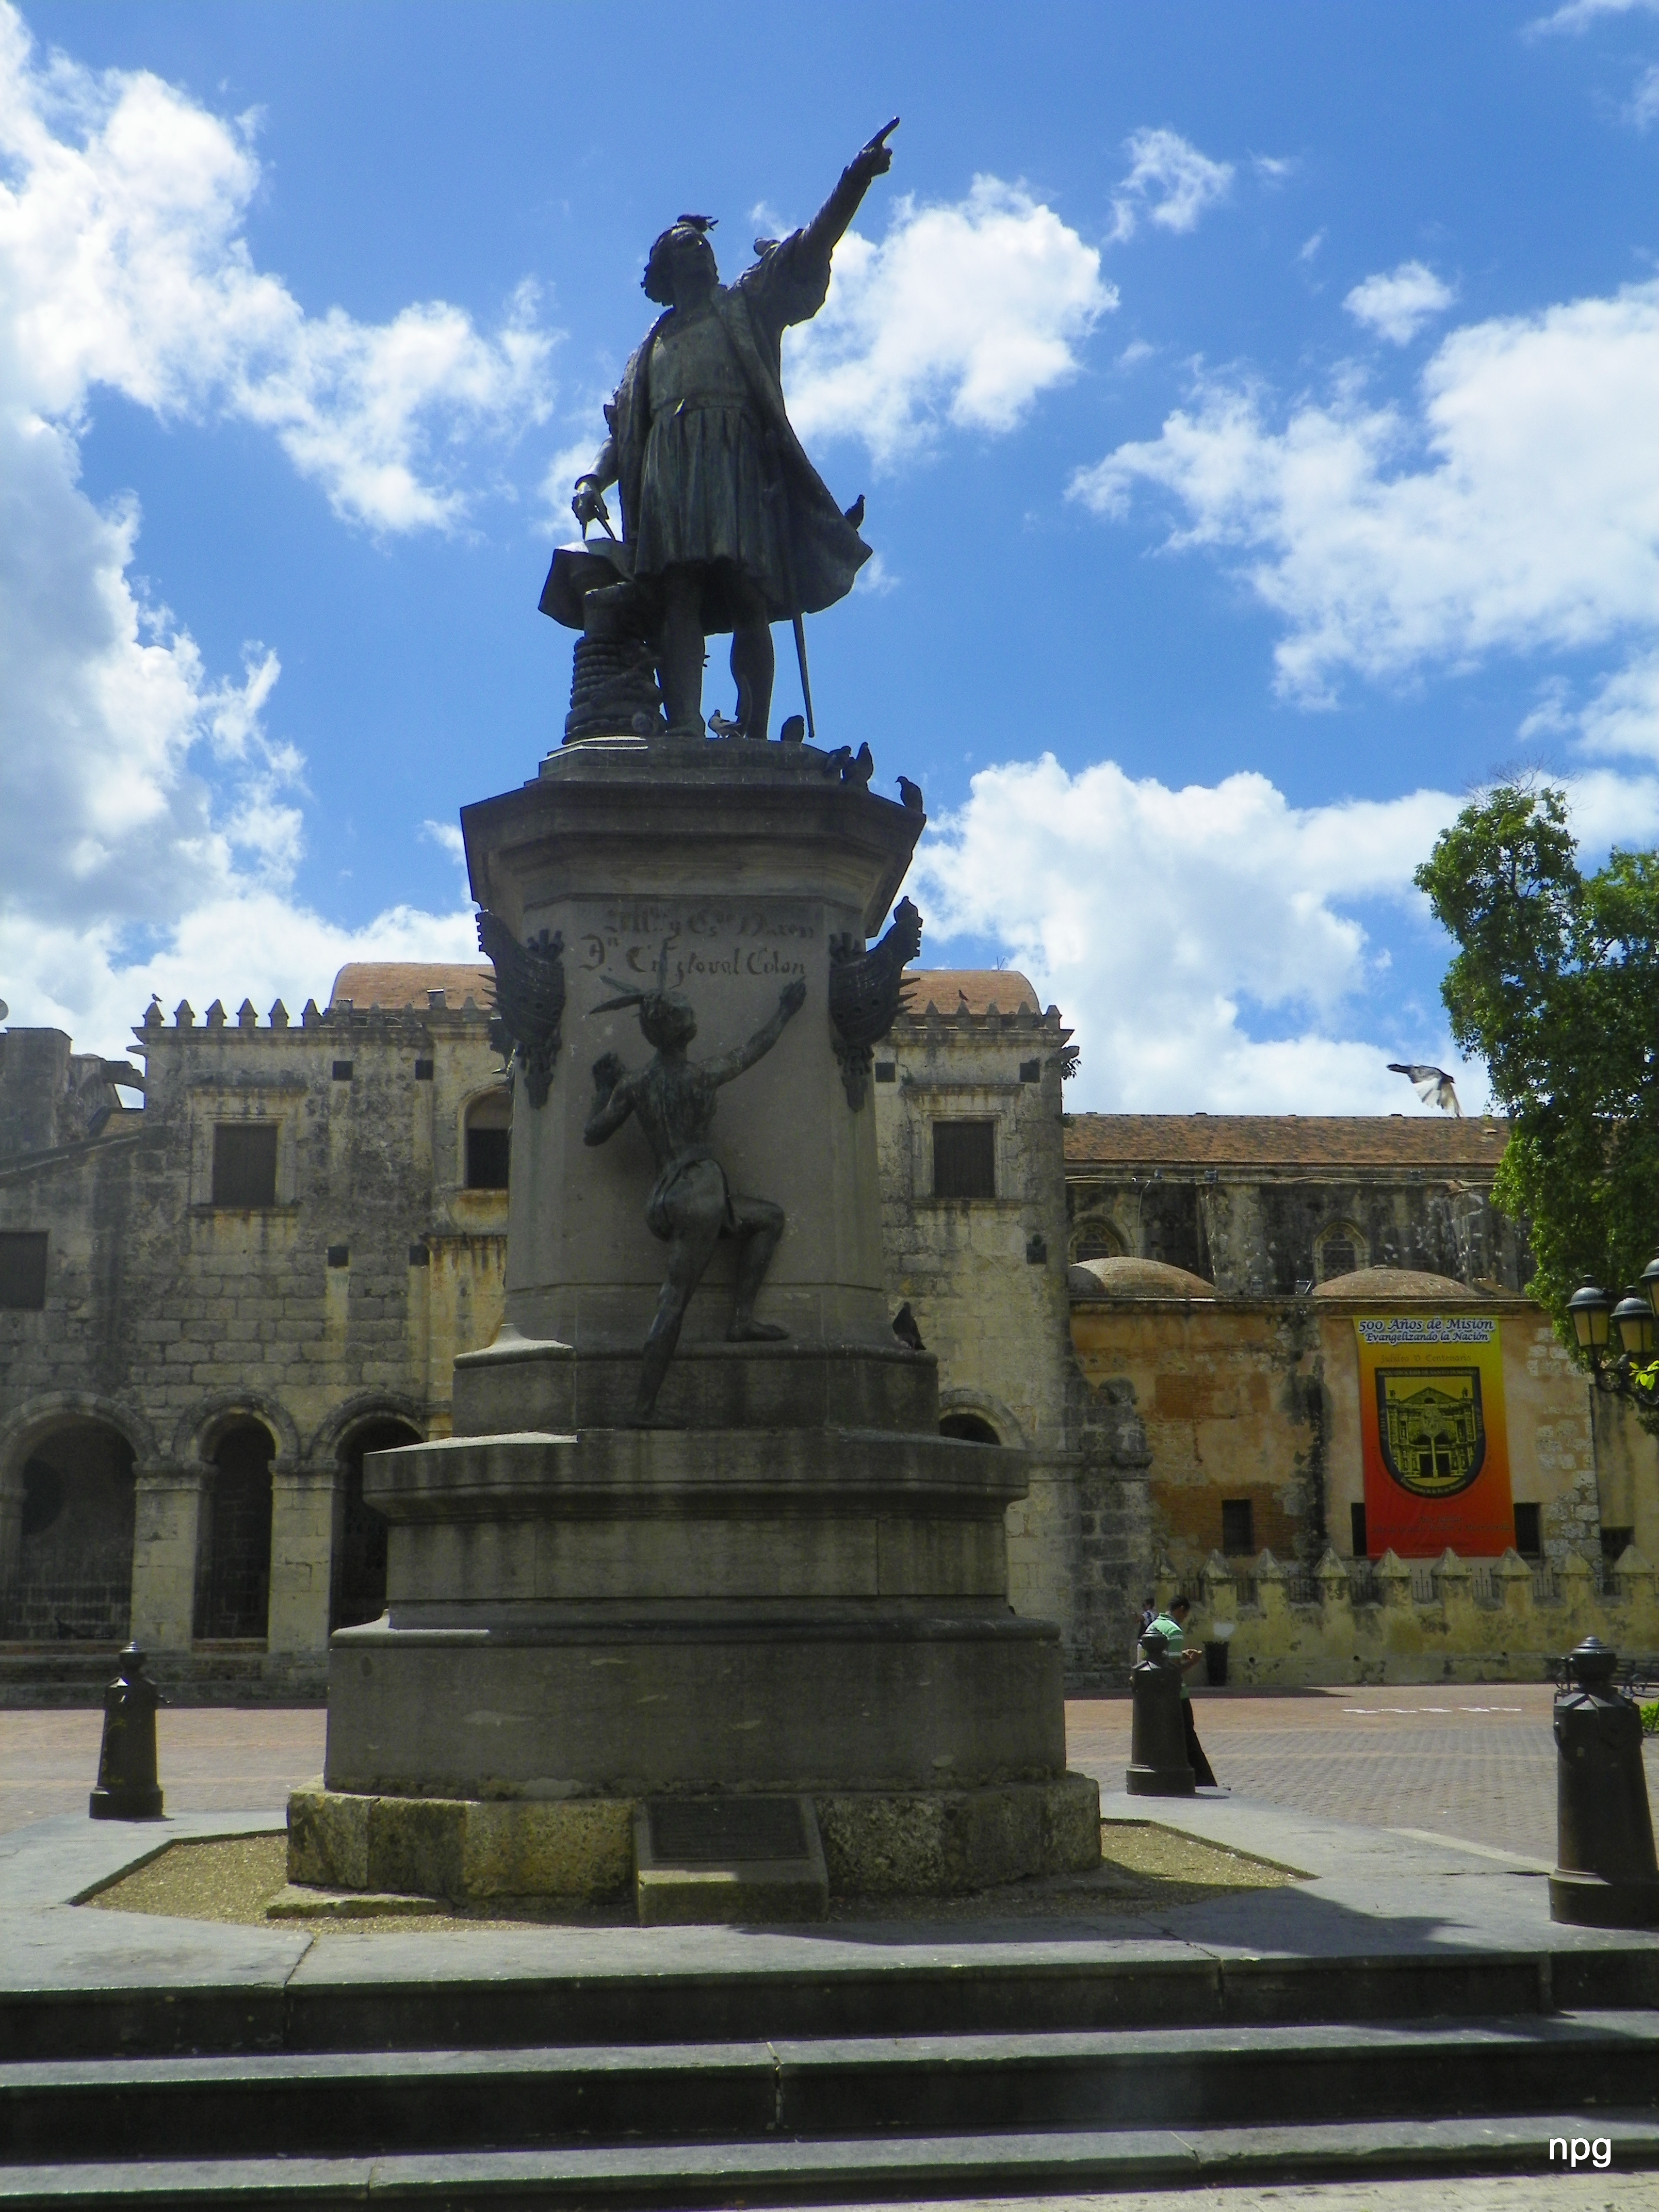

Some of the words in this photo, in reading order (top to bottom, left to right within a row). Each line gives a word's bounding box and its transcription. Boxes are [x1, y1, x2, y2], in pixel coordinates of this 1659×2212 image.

[1359, 1320, 1384, 1332] 500
[1388, 1318, 1423, 1330] Años
[1427, 1318, 1442, 1330] de
[1446, 1318, 1494, 1330] Misión
[1366, 1331, 1438, 1344] Evangelizando
[1441, 1331, 1450, 1341] la
[1452, 1331, 1489, 1341] Nación
